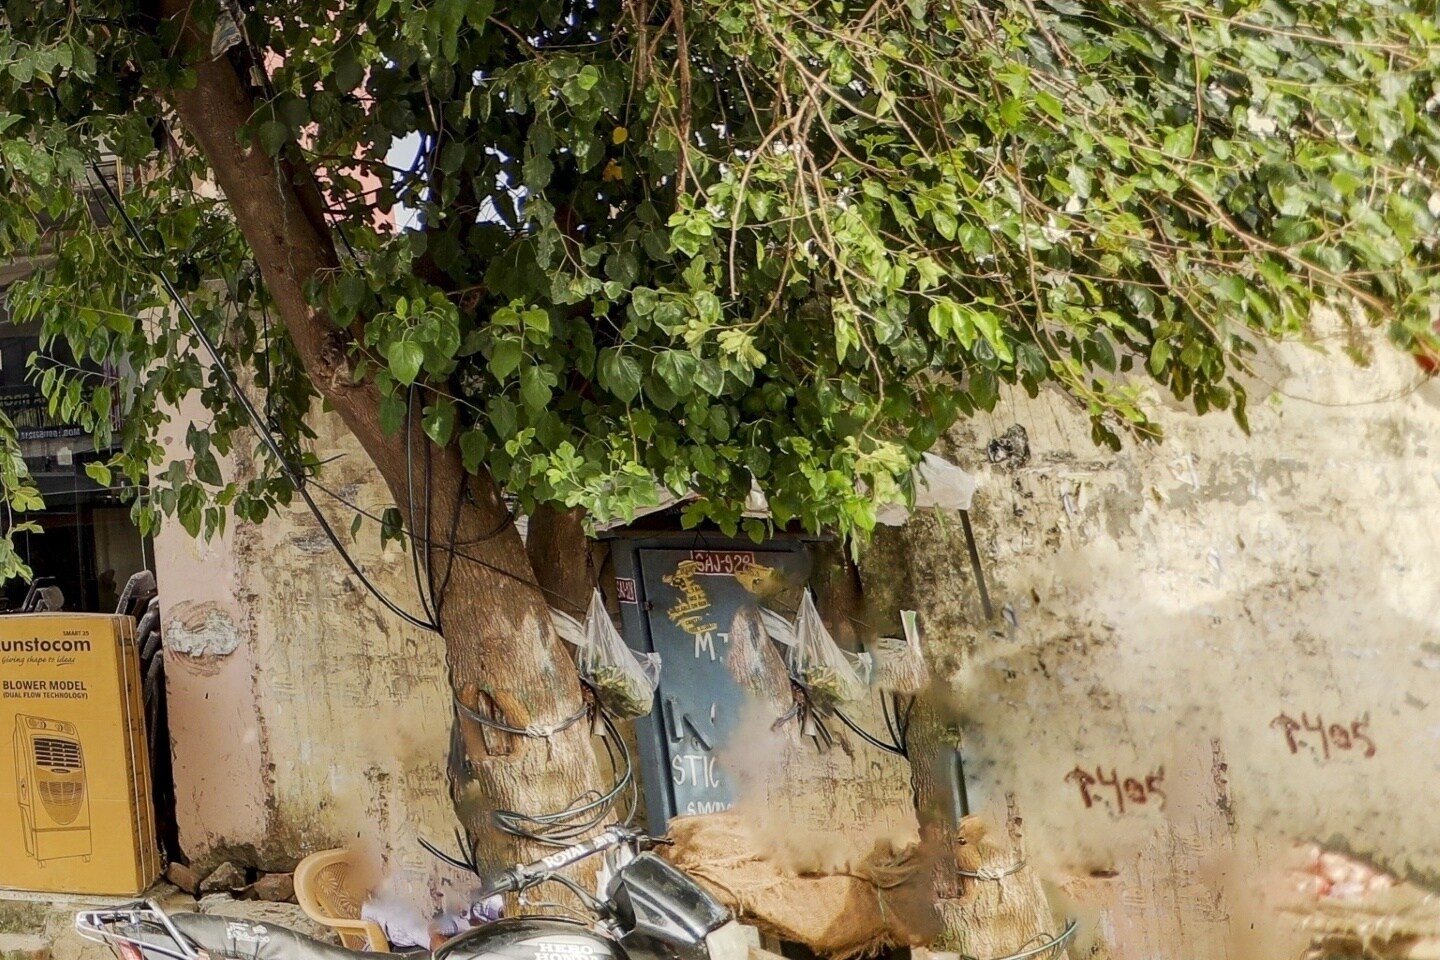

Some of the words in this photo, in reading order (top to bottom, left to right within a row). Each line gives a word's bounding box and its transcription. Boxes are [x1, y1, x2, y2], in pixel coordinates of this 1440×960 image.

[2, 656, 25, 667] Giving
[27, 655, 46, 666] shape
[57, 655, 75, 663] ideas
[3, 680, 46, 690] BLOWER
[49, 681, 87, 690] MODEL
[3, 691, 22, 699] (DUAL
[44, 692, 88, 700] TECHNOLOGY)
[543, 844, 589, 868] ROYAL
[538, 943, 594, 955] HERO
